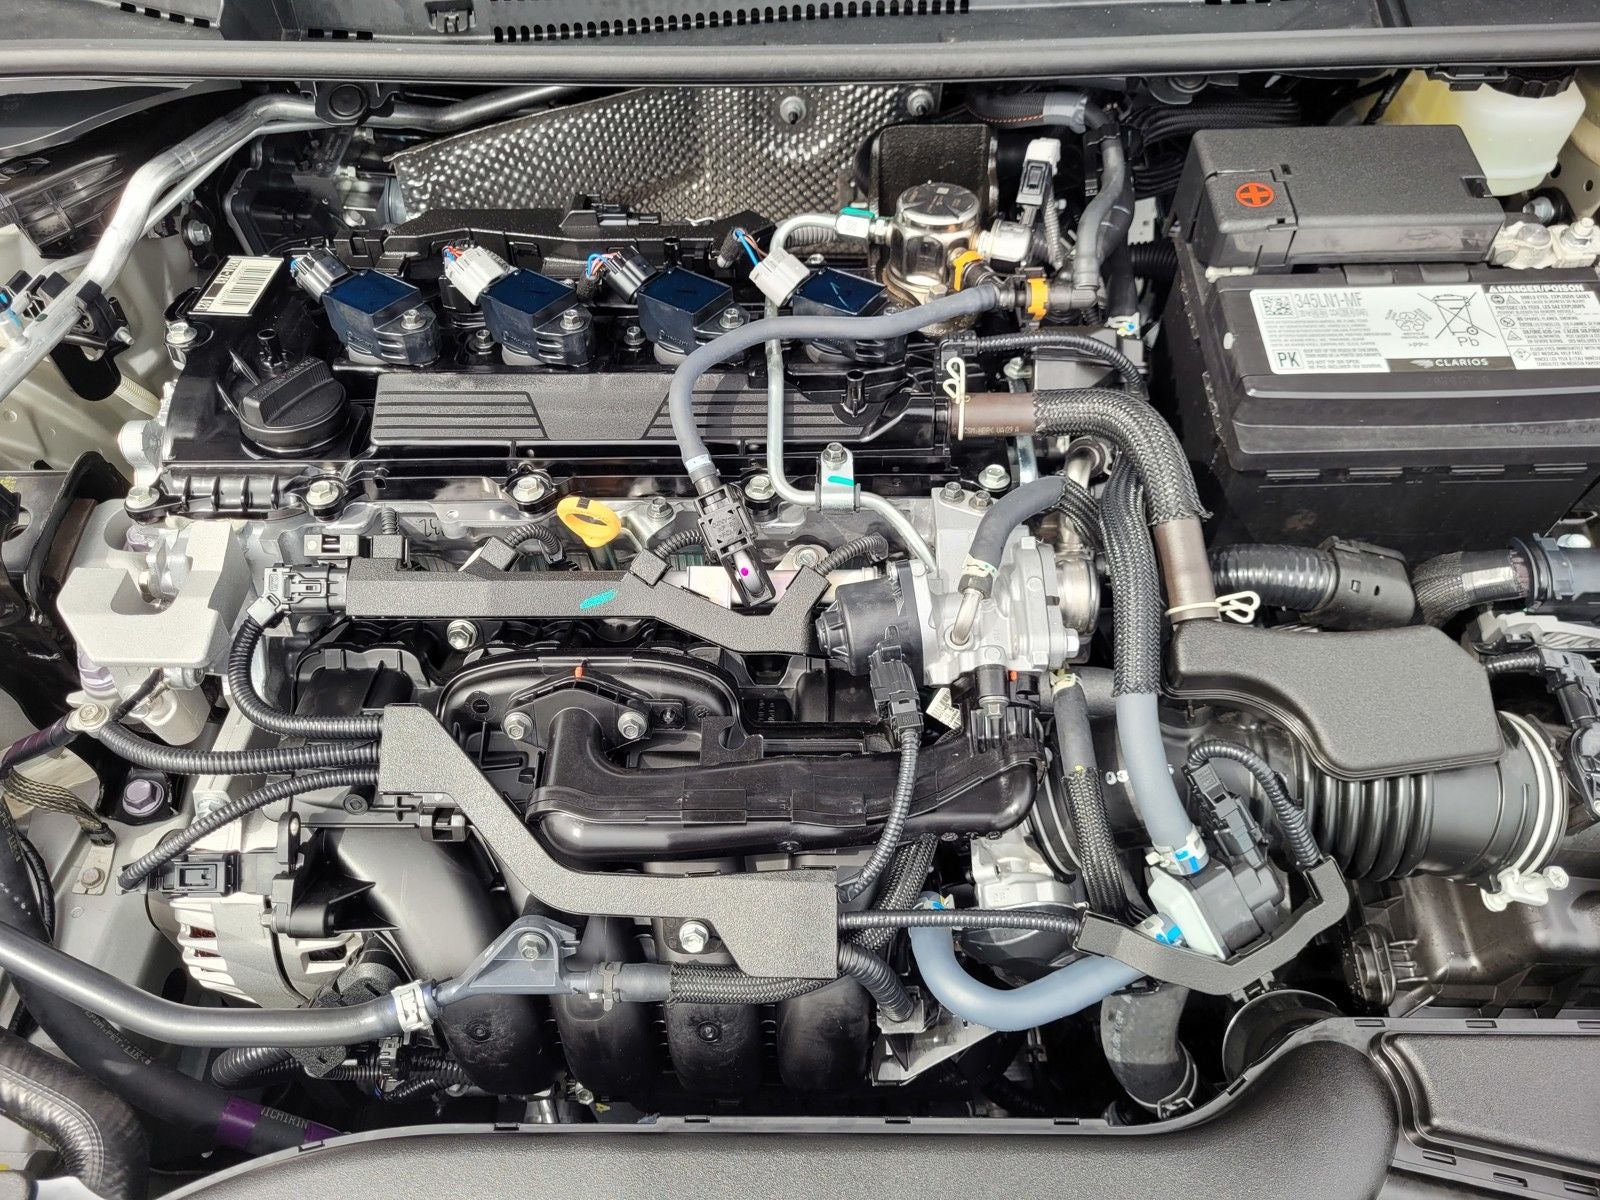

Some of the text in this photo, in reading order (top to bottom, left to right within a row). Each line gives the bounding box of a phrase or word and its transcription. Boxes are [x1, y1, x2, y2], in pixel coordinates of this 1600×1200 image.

[1497, 284, 1585, 293] DANGER/POISON
[1294, 292, 1363, 309] 345LN1-MF
[1457, 336, 1480, 347] Pb
[1277, 351, 1300, 368] PK
[1434, 358, 1489, 367] CLARIOS
